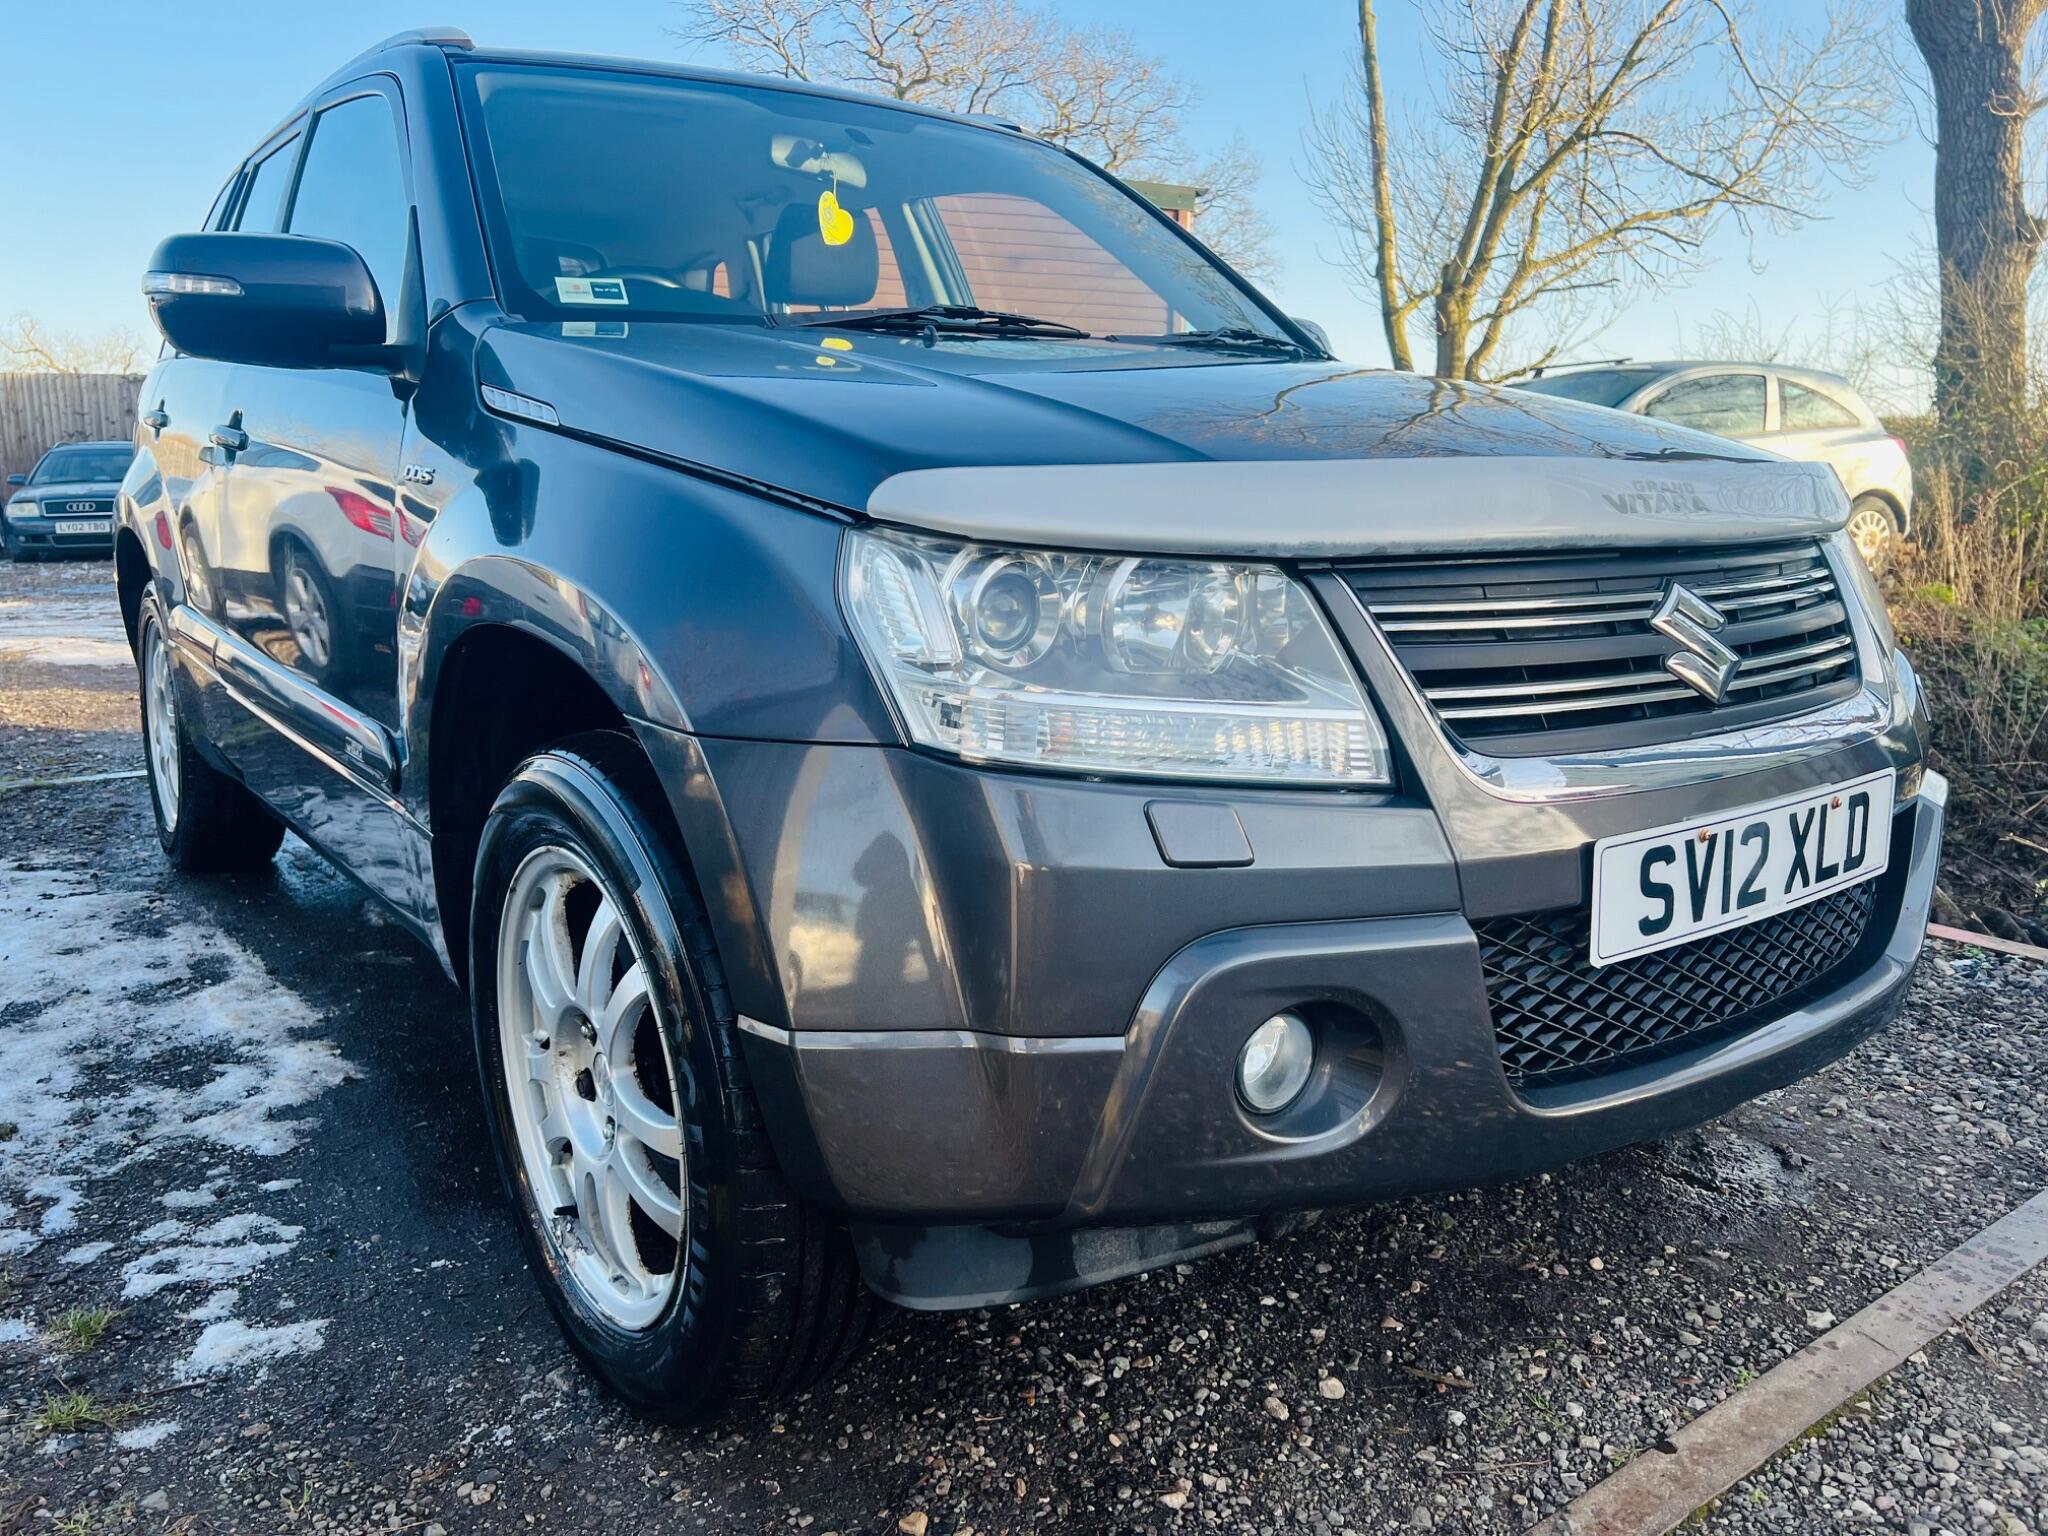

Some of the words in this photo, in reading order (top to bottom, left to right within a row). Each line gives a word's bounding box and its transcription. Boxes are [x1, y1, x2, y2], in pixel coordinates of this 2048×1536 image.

[1601, 493, 1712, 514] VITARA
[1638, 821, 1771, 937] SV12
[1784, 791, 1870, 895] XLD
